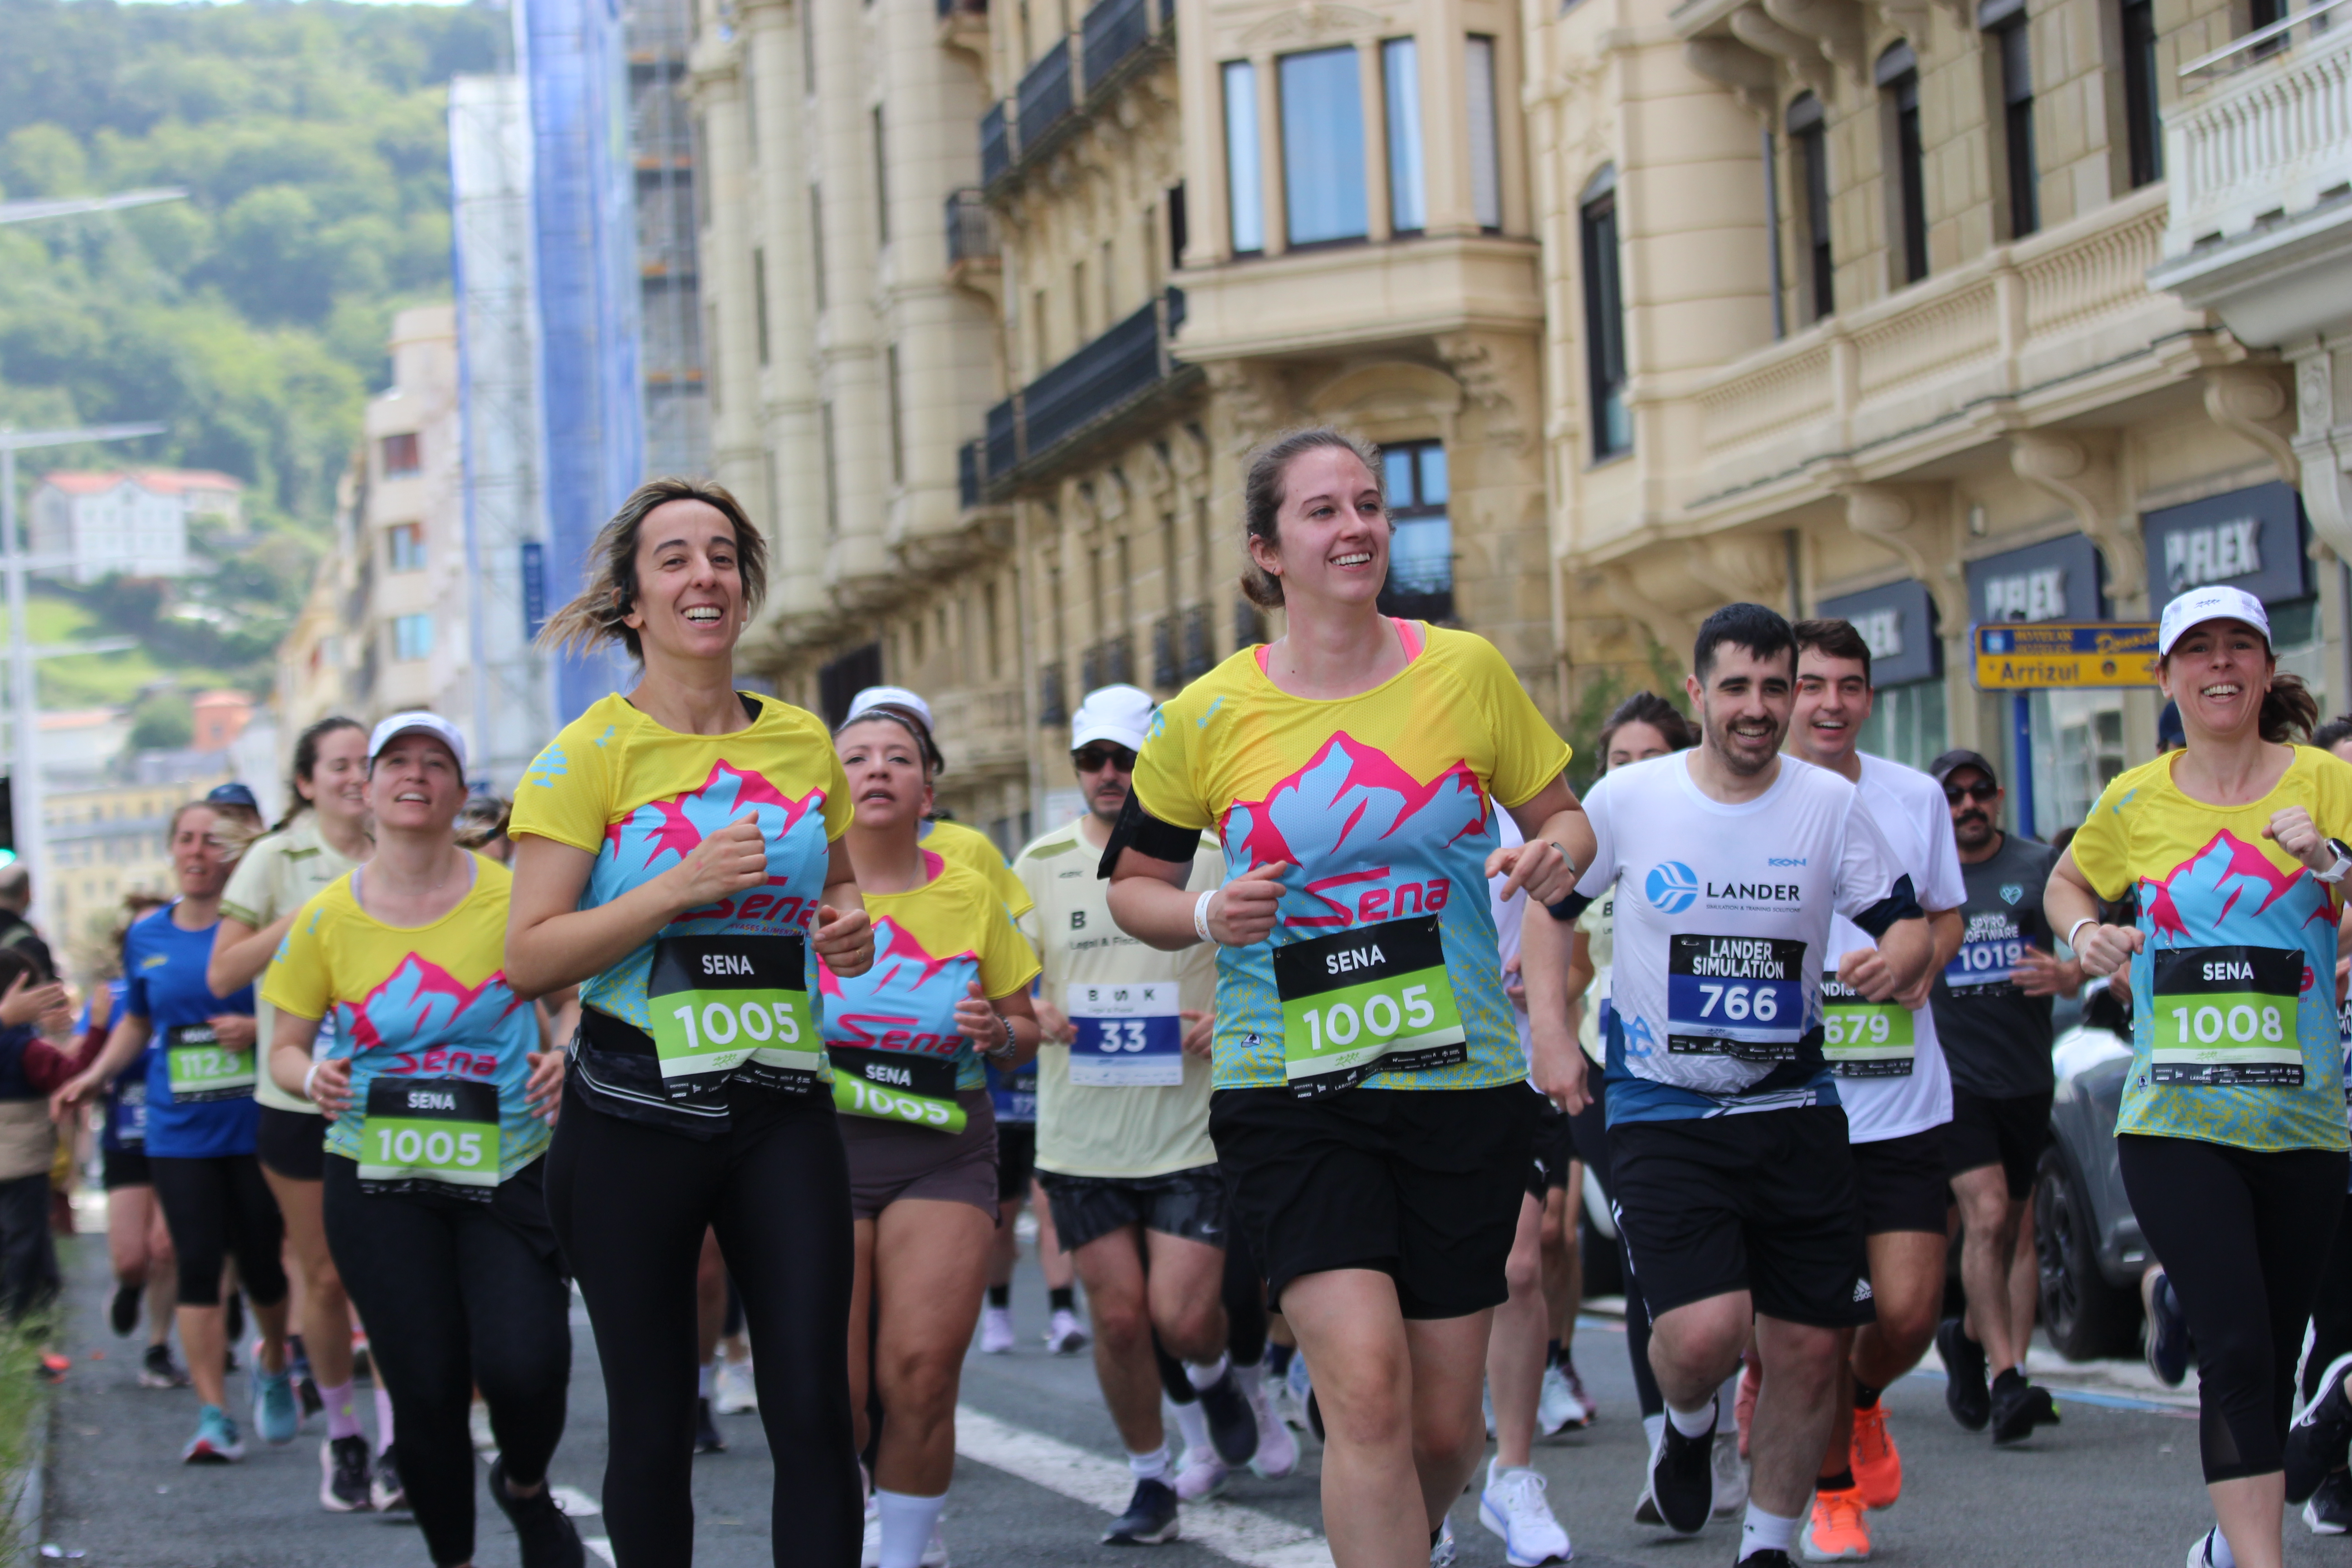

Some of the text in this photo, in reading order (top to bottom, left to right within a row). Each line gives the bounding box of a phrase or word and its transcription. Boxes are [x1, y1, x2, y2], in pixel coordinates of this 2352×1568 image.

[2002, 662, 2080, 681] Arrizul
[1284, 867, 1450, 927] Sena
[1707, 882, 1800, 901] LANDER
[1071, 911, 1086, 929] B
[1070, 938, 1098, 950] Legal
[1101, 937, 1109, 947] &
[1710, 939, 1772, 960] LANDER
[1958, 942, 2022, 971] 1019
[702, 955, 755, 975] SENA
[1326, 945, 1386, 975] SENA
[1692, 957, 1784, 979] SIMULATION
[2203, 961, 2254, 981] SENA
[1303, 984, 1435, 1050] 1005
[1699, 985, 1777, 1022] 766
[673, 1002, 799, 1048] 1005
[825, 1014, 964, 1055] Sena
[1099, 1021, 1147, 1053] 33
[1824, 1015, 1890, 1044] 679
[2172, 1005, 2283, 1043] 1008
[865, 1064, 912, 1087] SENA
[1335, 1080, 1357, 1090] LABORAL
[408, 1091, 456, 1110] SENA
[850, 1080, 950, 1125] 1005
[377, 1128, 482, 1166] 1005
